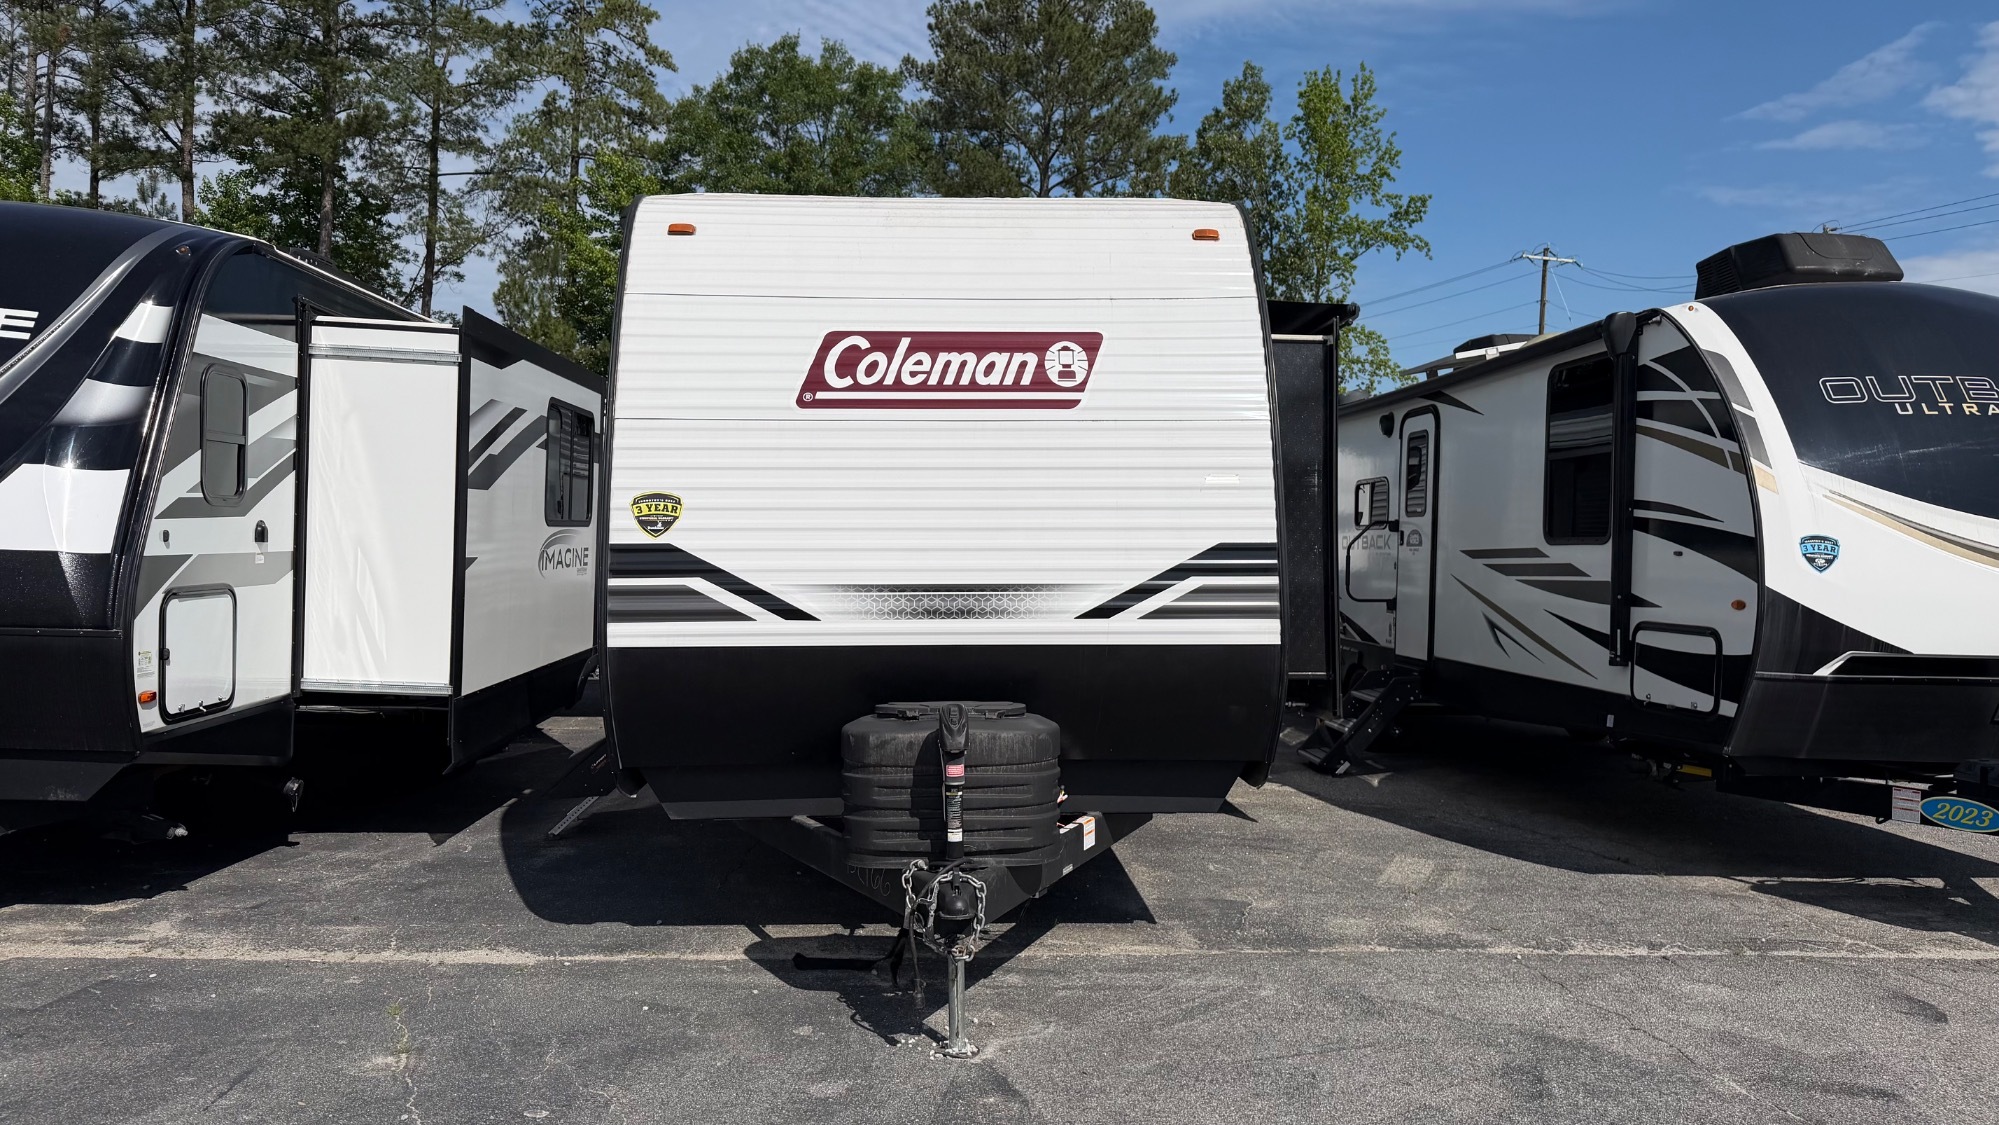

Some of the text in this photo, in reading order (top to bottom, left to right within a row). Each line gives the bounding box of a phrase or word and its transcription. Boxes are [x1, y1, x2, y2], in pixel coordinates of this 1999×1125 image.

[823, 335, 1038, 388] Coleman
[1818, 375, 1999, 404] OUTB
[1894, 402, 1999, 416] ULTRA
[635, 503, 679, 515] 3 YEAR
[541, 547, 589, 571] IMAGINE
[1802, 544, 1837, 554] 3 YEAR
[1932, 802, 1994, 827] 2023
